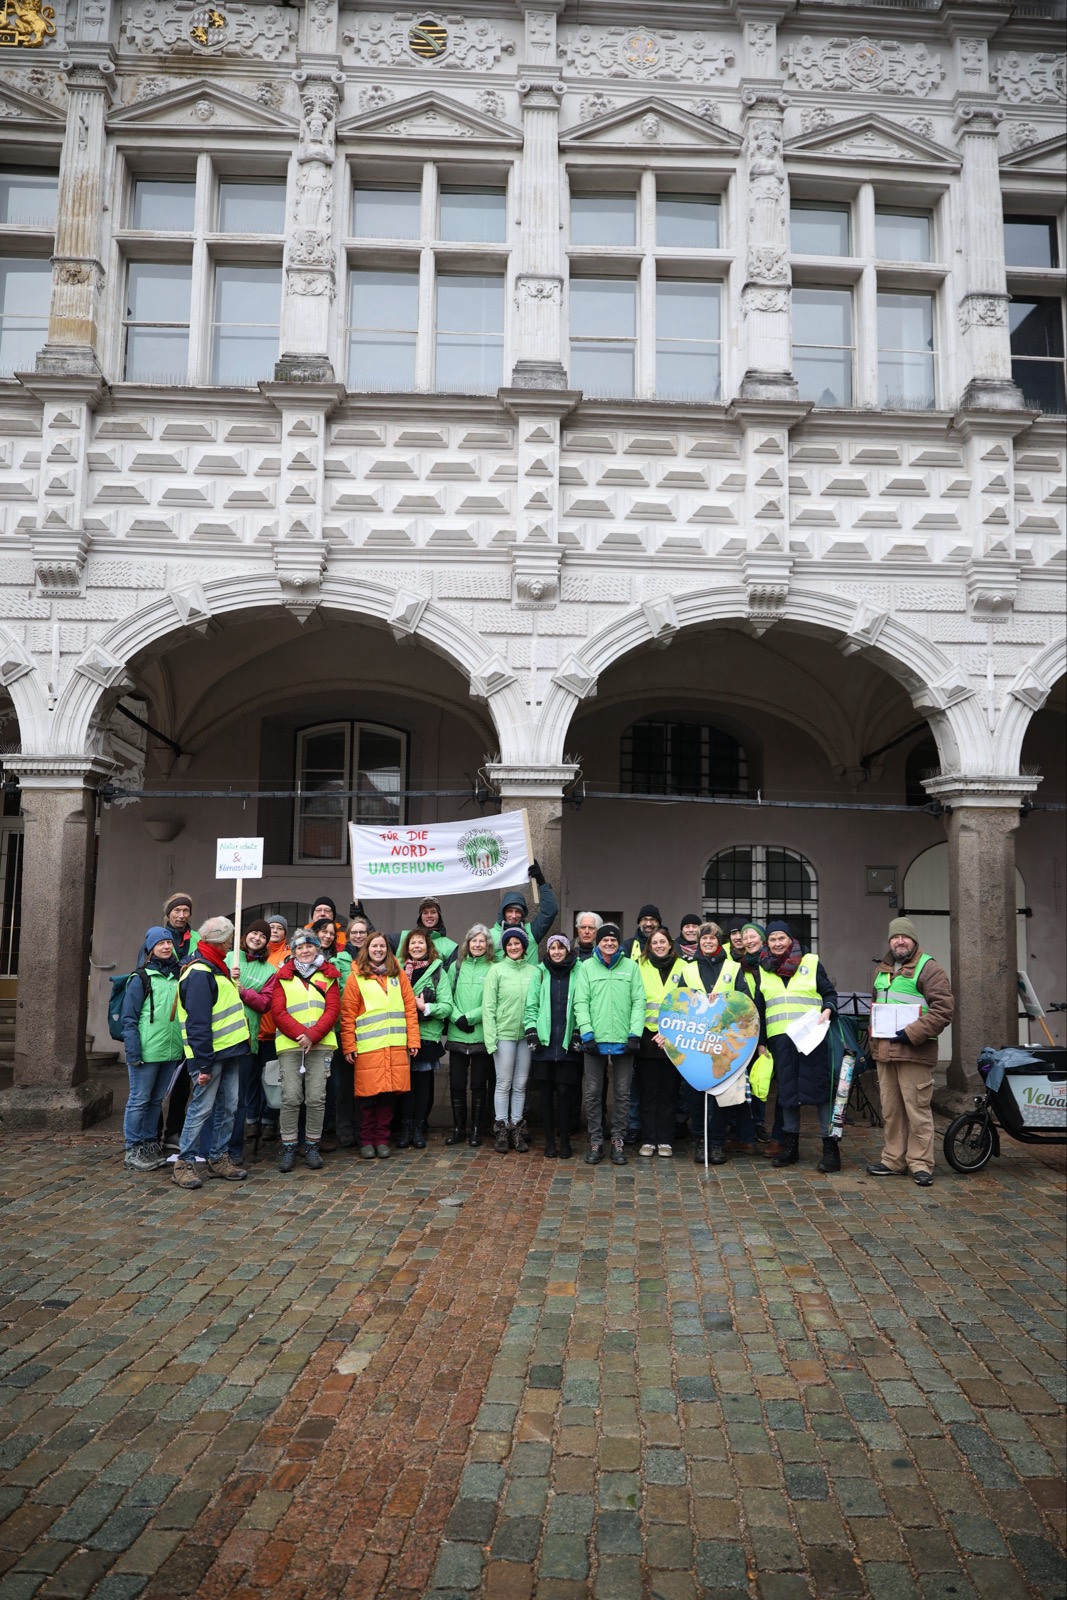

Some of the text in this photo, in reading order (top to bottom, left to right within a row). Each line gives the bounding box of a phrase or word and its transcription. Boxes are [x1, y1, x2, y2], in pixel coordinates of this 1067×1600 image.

[379, 830, 428, 842] FÜR DIE
[232, 851, 242, 863] &
[391, 844, 436, 858] NORD-
[368, 861, 445, 875] UMGEHUNG
[660, 1017, 706, 1035] omas
[704, 1030, 723, 1043] for
[674, 1033, 723, 1055] future
